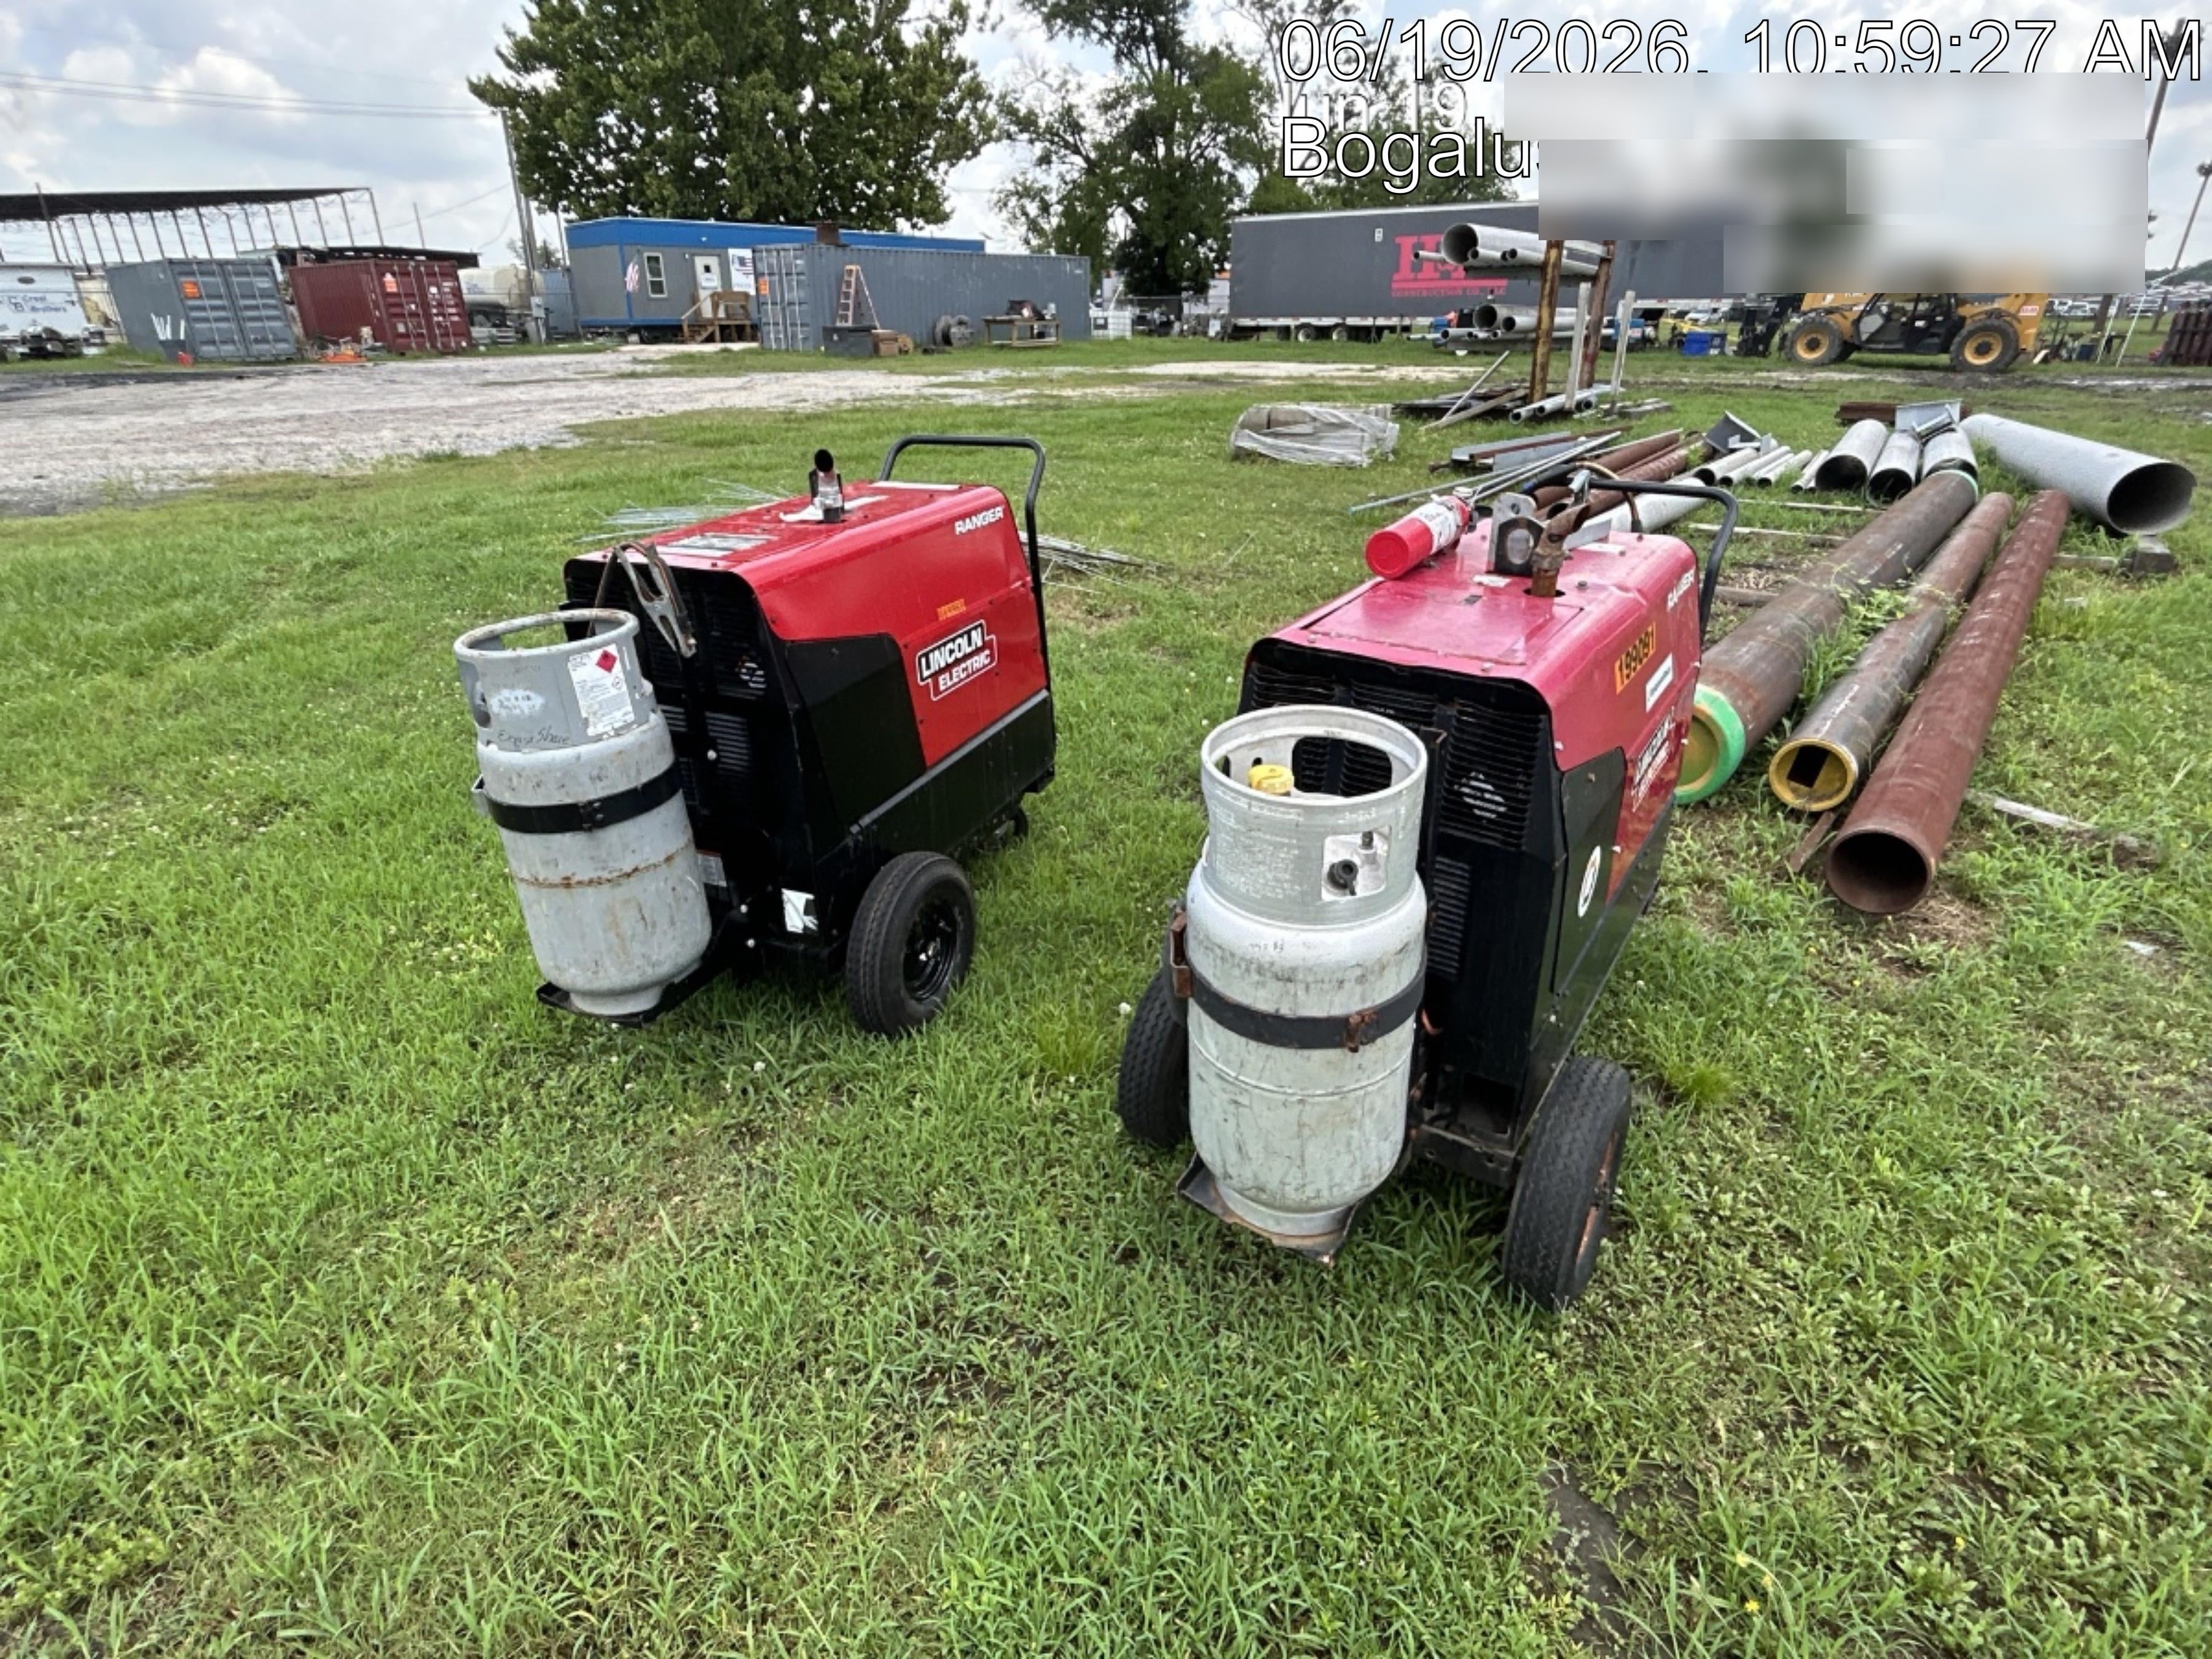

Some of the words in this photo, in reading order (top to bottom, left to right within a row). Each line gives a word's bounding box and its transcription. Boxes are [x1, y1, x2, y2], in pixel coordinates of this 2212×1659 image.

[954, 506, 1004, 536] RANGER
[1667, 568, 1695, 611] RANGER
[921, 626, 982, 679] LINCOLN
[938, 649, 991, 692] ELECTRIC
[1618, 624, 1654, 684] 199091
